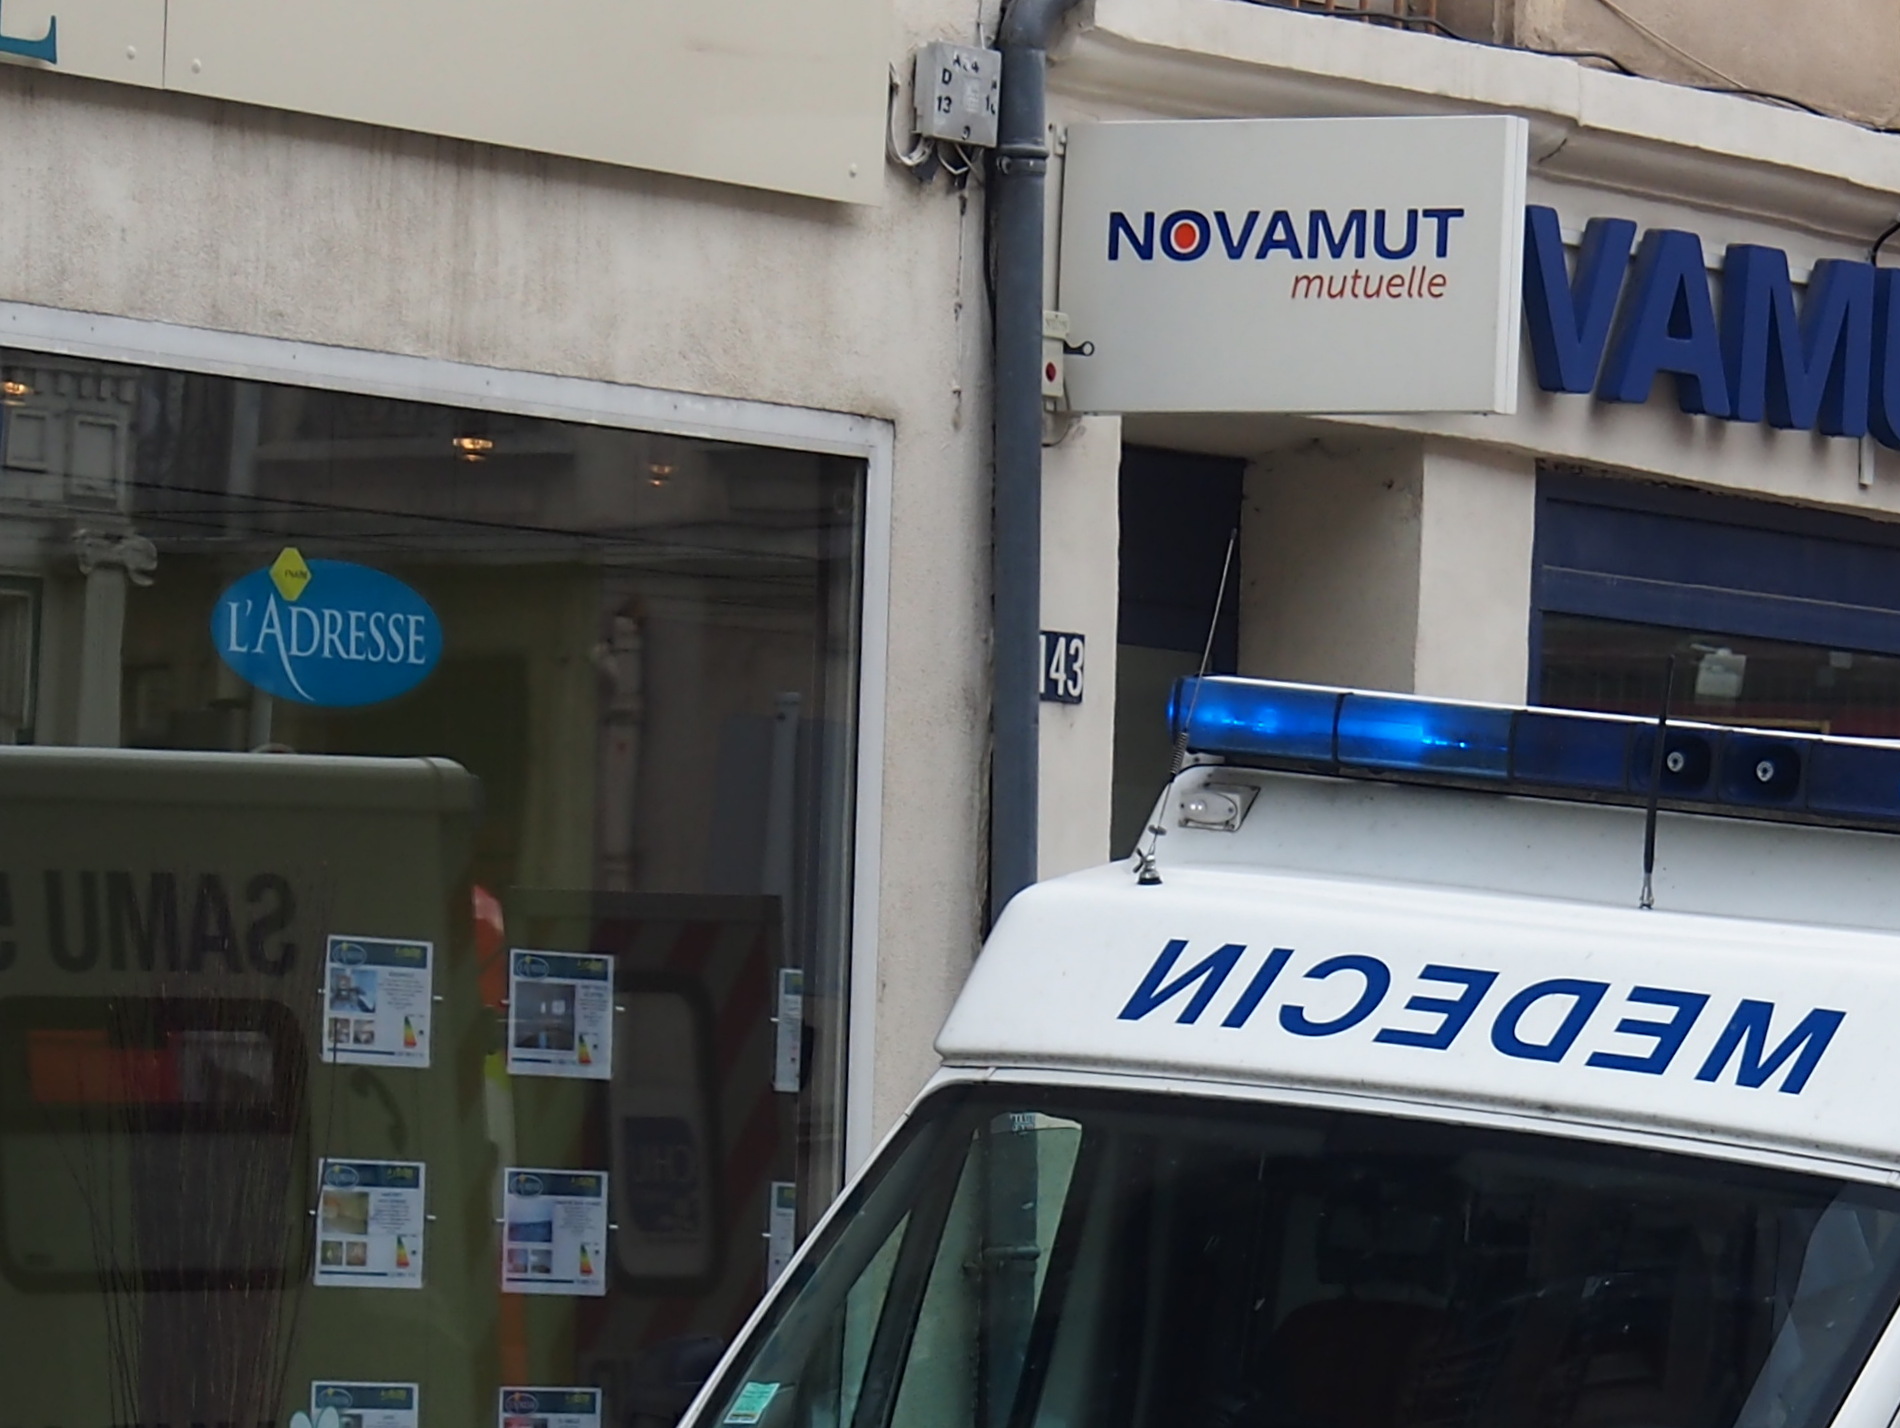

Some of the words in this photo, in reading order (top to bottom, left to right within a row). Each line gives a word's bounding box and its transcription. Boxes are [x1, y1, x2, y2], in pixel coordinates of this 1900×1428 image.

[1107, 208, 1465, 262] NOVAMUT
[1290, 265, 1448, 299] mutuelle
[227, 592, 426, 701] L'ADRESSE
